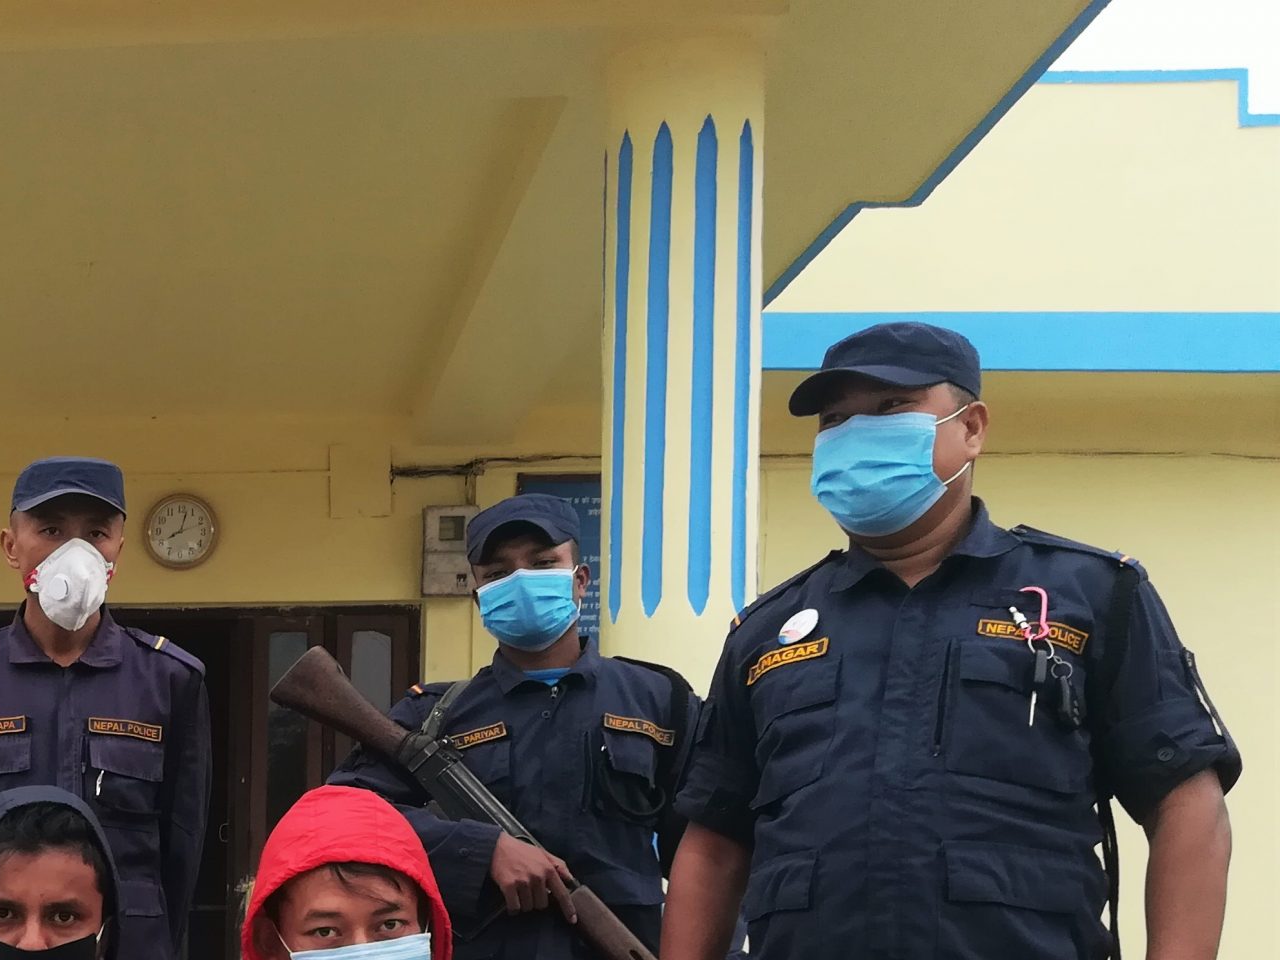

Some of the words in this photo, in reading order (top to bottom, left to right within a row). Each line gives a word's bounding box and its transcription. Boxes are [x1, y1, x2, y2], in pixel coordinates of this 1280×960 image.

[986, 623, 1026, 637] NEPA
[1039, 627, 1082, 648] OLICE
[761, 644, 819, 669] MAGAR
[93, 720, 126, 732] NEPAL
[127, 724, 158, 738] POLICE
[463, 727, 501, 744] PARIYAR
[608, 717, 641, 730] NEPAL
[642, 723, 671, 742] POLICE
